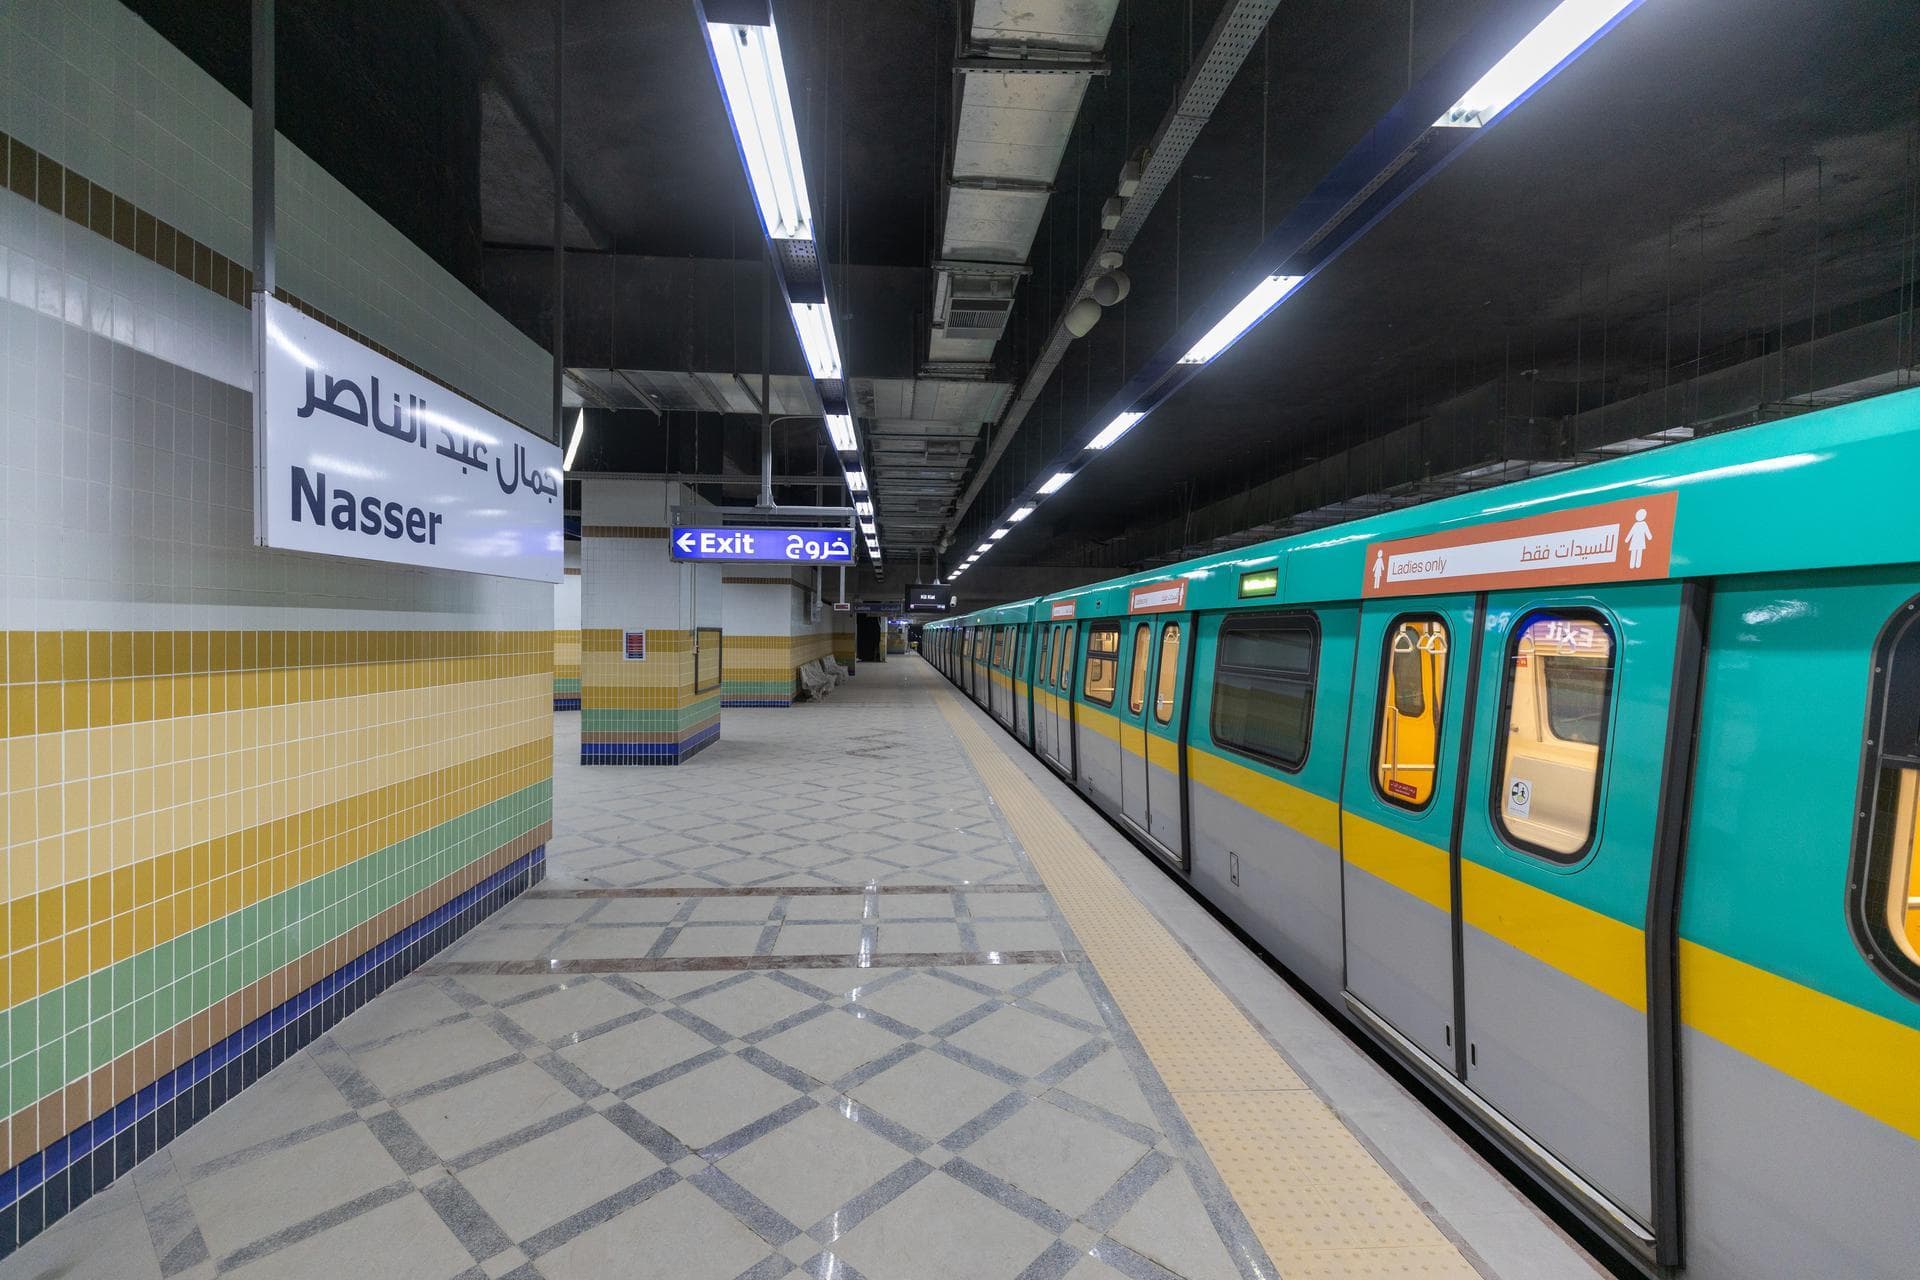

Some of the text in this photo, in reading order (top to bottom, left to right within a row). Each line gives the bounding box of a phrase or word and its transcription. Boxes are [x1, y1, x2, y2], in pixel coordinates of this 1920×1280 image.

[297, 366, 558, 504] جمال عبد الناصر
[290, 465, 442, 545] Nasser
[700, 532, 755, 554] Exit
[785, 534, 849, 559] خروج
[1520, 534, 1615, 563] للسيدات فقط
[1392, 556, 1448, 576] Ladies only
